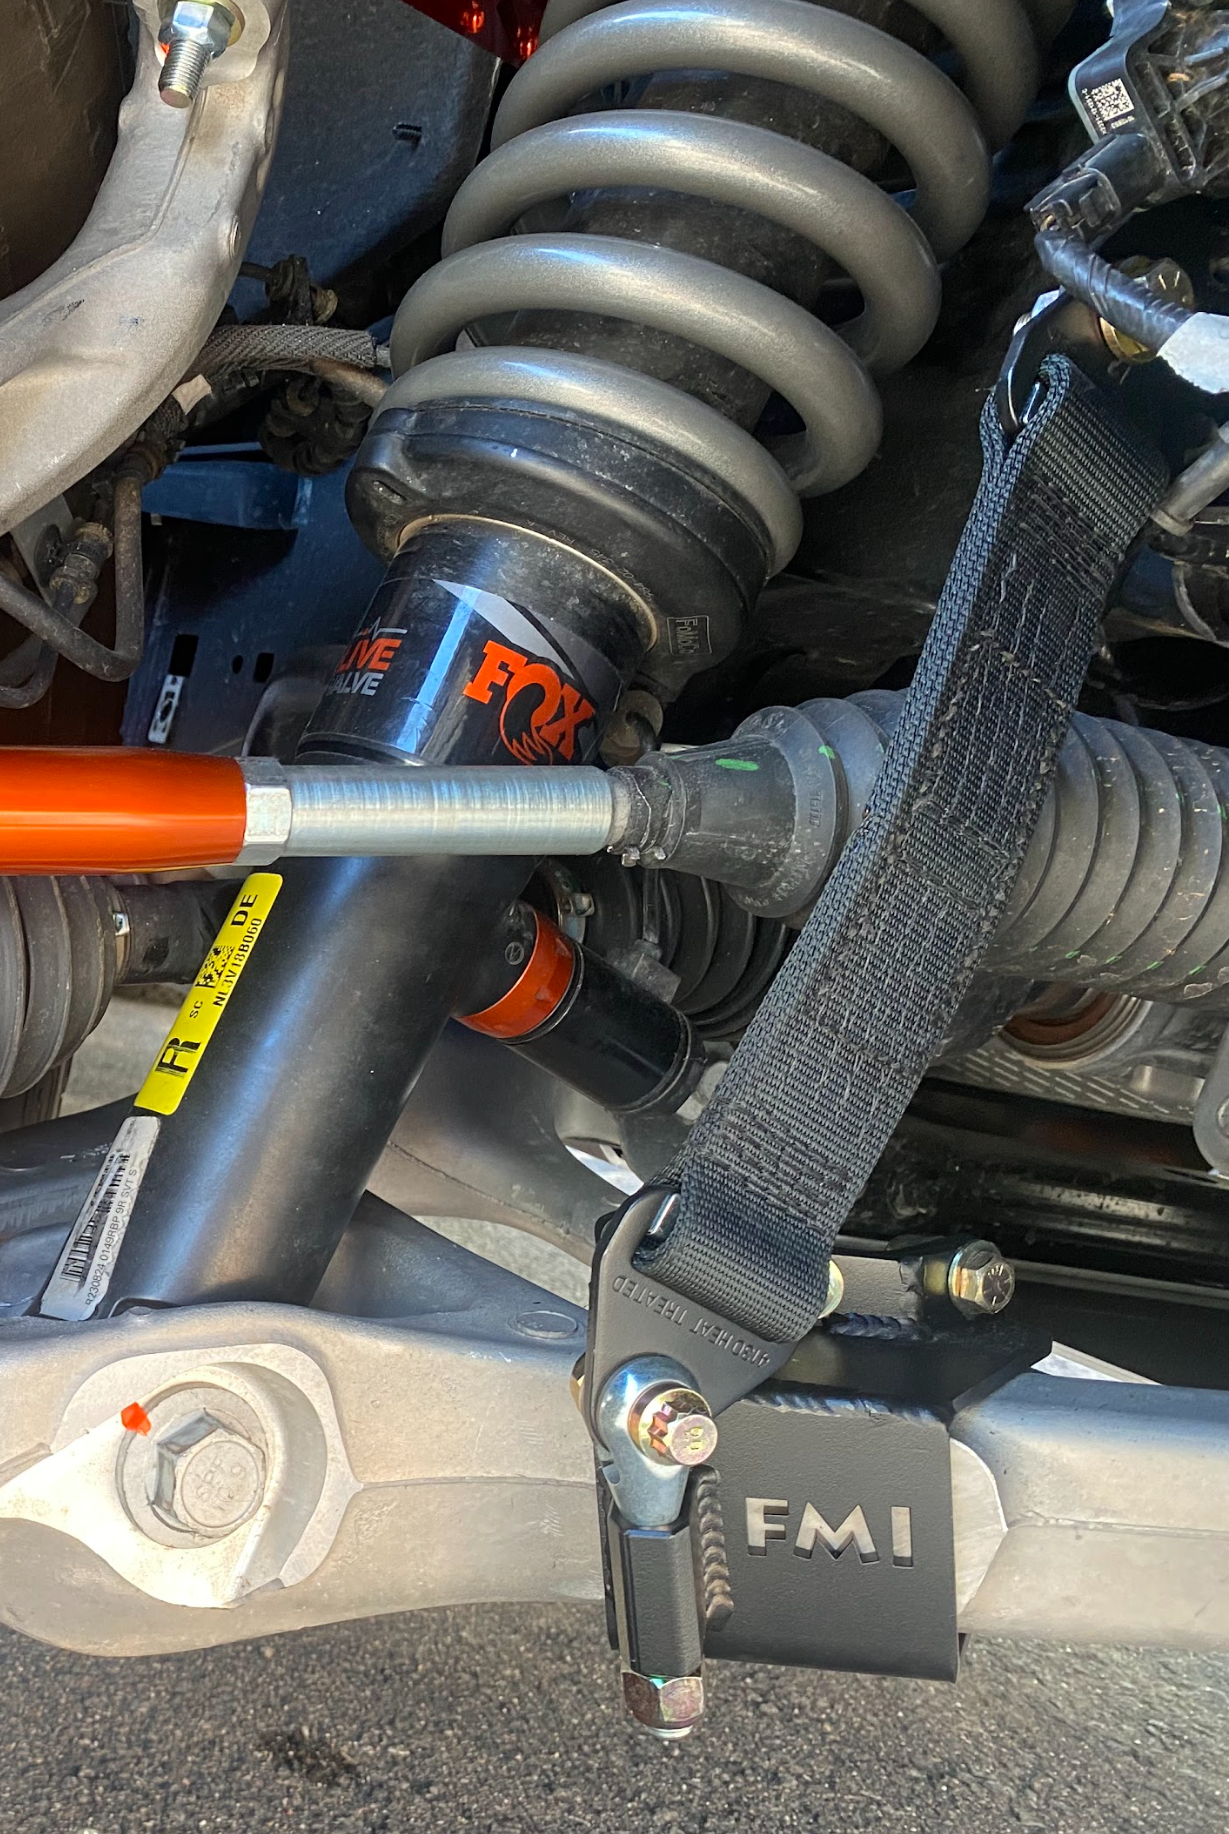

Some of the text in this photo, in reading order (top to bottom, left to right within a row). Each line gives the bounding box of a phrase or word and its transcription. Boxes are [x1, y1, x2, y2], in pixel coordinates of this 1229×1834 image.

[326, 671, 384, 696] ALVE
[463, 640, 596, 766] FOX
[230, 893, 258, 927] DE
[155, 1036, 202, 1078] R
[120, 1177, 133, 1198] SVT
[611, 1274, 771, 1369] 4130 HEAT TREATED
[746, 1497, 914, 1568] FMI
